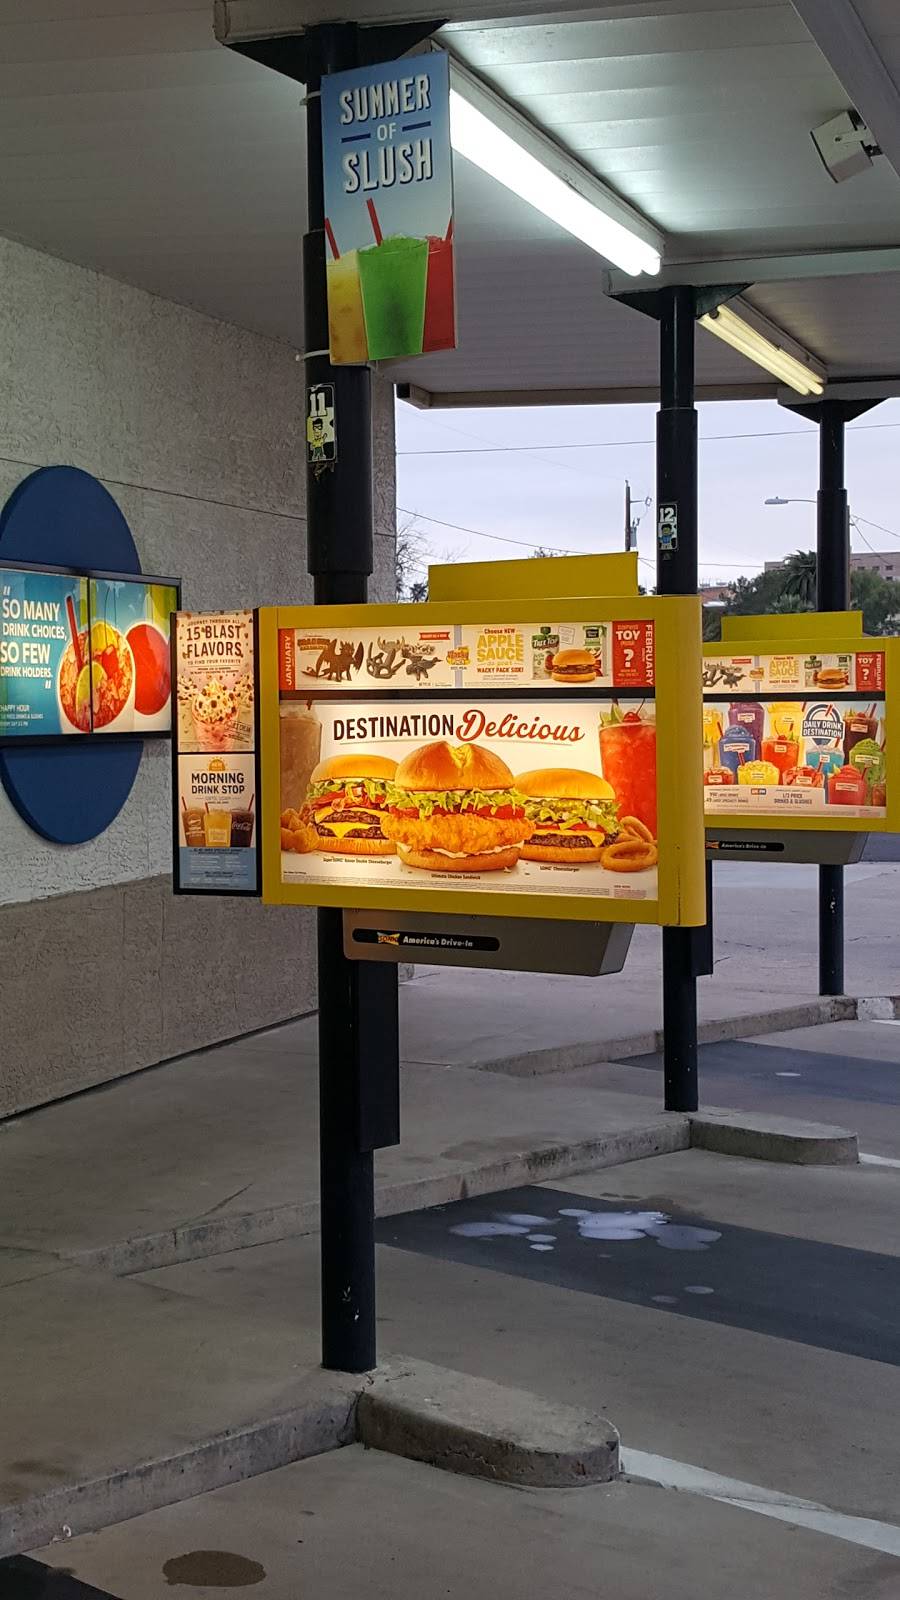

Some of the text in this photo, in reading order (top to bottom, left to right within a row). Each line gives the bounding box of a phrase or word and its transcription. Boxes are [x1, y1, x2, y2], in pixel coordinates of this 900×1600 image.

[340, 73, 431, 125] SUMMER
[377, 123, 397, 140] OF
[343, 138, 433, 193] SLUSH
[310, 392, 327, 417] 11
[660, 508, 674, 523] 12
[3, 599, 60, 621] SO MANY
[3, 622, 67, 641] DRINK CHOICES,
[187, 624, 241, 641] 15 BLAST
[615, 630, 640, 641] TOY
[477, 634, 524, 648] APPLE
[1, 642, 50, 664] SO FEW
[187, 641, 242, 659] FLAVORS
[477, 647, 524, 662] SAUCE
[623, 648, 634, 668] ?
[645, 624, 654, 686] FEBRUARY
[284, 635, 293, 686] JANUARY
[0, 666, 53, 678] DRINK HOLDERS.
[862, 668, 869, 680] ?
[16, 704, 30, 712] HOUR
[333, 709, 585, 743] DESTINATION Delicious
[803, 720, 820, 728] DAILY
[822, 721, 842, 729] DRINK
[803, 728, 842, 737] DESTINATION
[191, 772, 244, 784] MORNING
[191, 784, 245, 794] DRINK STOP
[403, 936, 440, 945] America's
[441, 937, 473, 947] Drive-In
